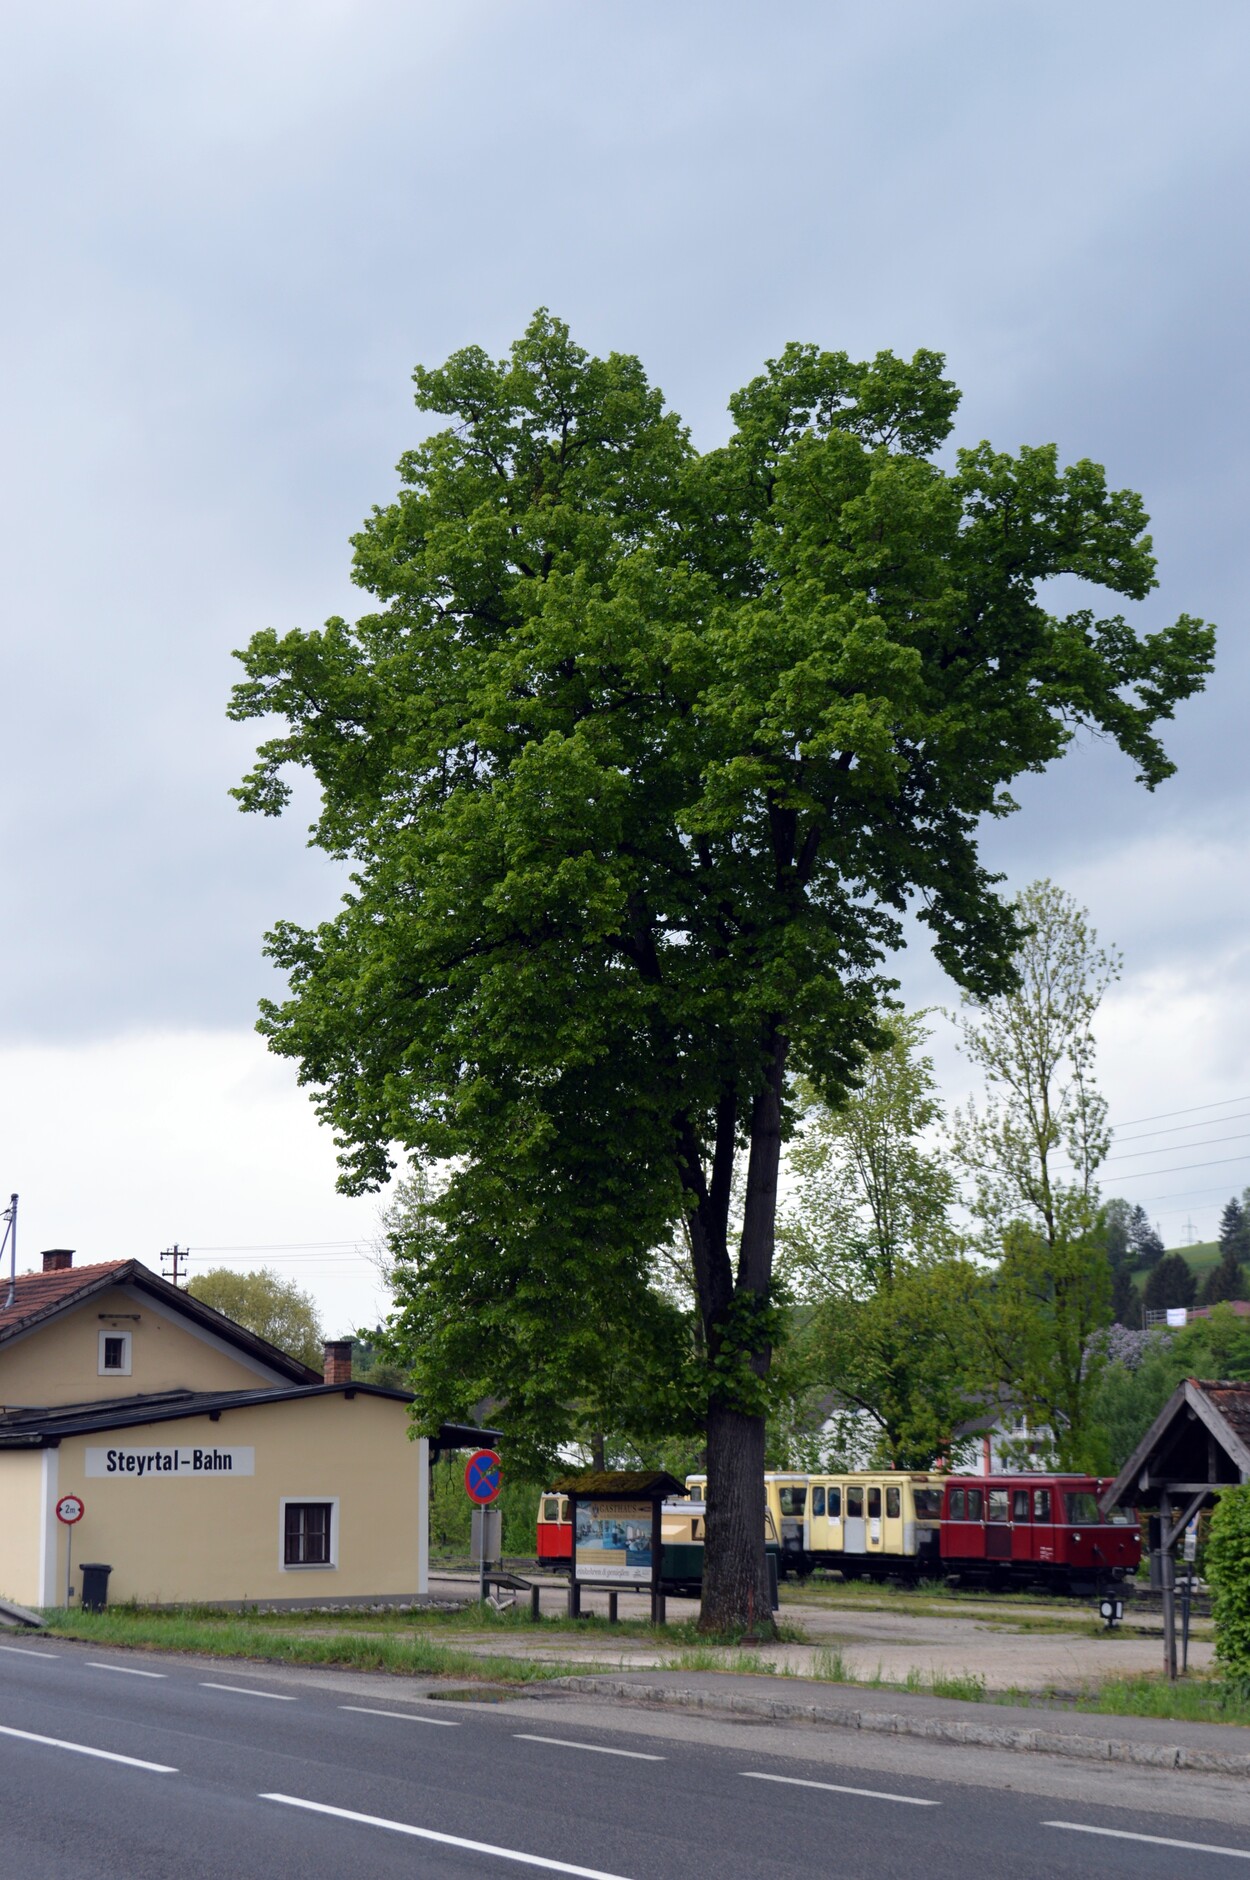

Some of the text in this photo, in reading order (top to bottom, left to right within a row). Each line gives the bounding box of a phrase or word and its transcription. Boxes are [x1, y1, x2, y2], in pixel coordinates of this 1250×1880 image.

[106, 1449, 232, 1476] Steyrtal-Bahn
[65, 1504, 76, 1514] 2m
[599, 1503, 637, 1513] GASTHAUS
